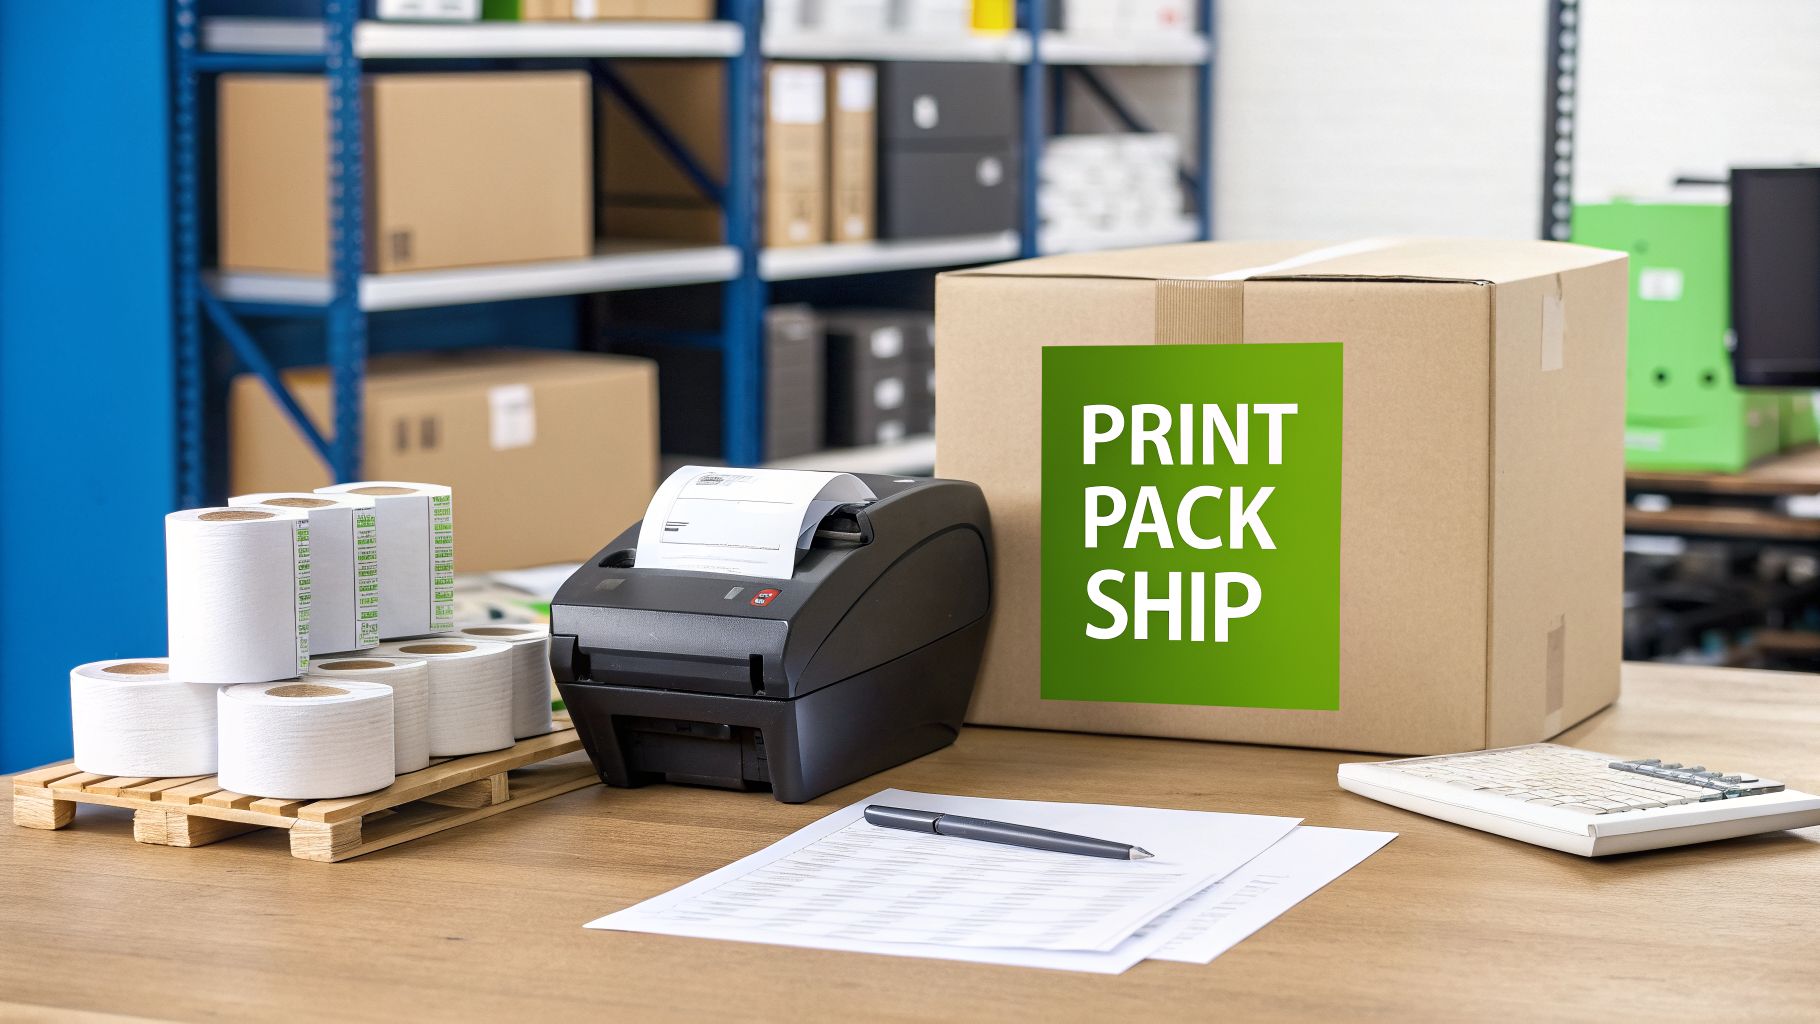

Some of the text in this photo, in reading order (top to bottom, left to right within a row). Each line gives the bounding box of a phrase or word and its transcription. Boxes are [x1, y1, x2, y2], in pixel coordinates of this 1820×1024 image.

[1083, 403, 1298, 465] PRINT
[1084, 485, 1277, 550] PACK
[1085, 569, 1262, 642] SHIP
